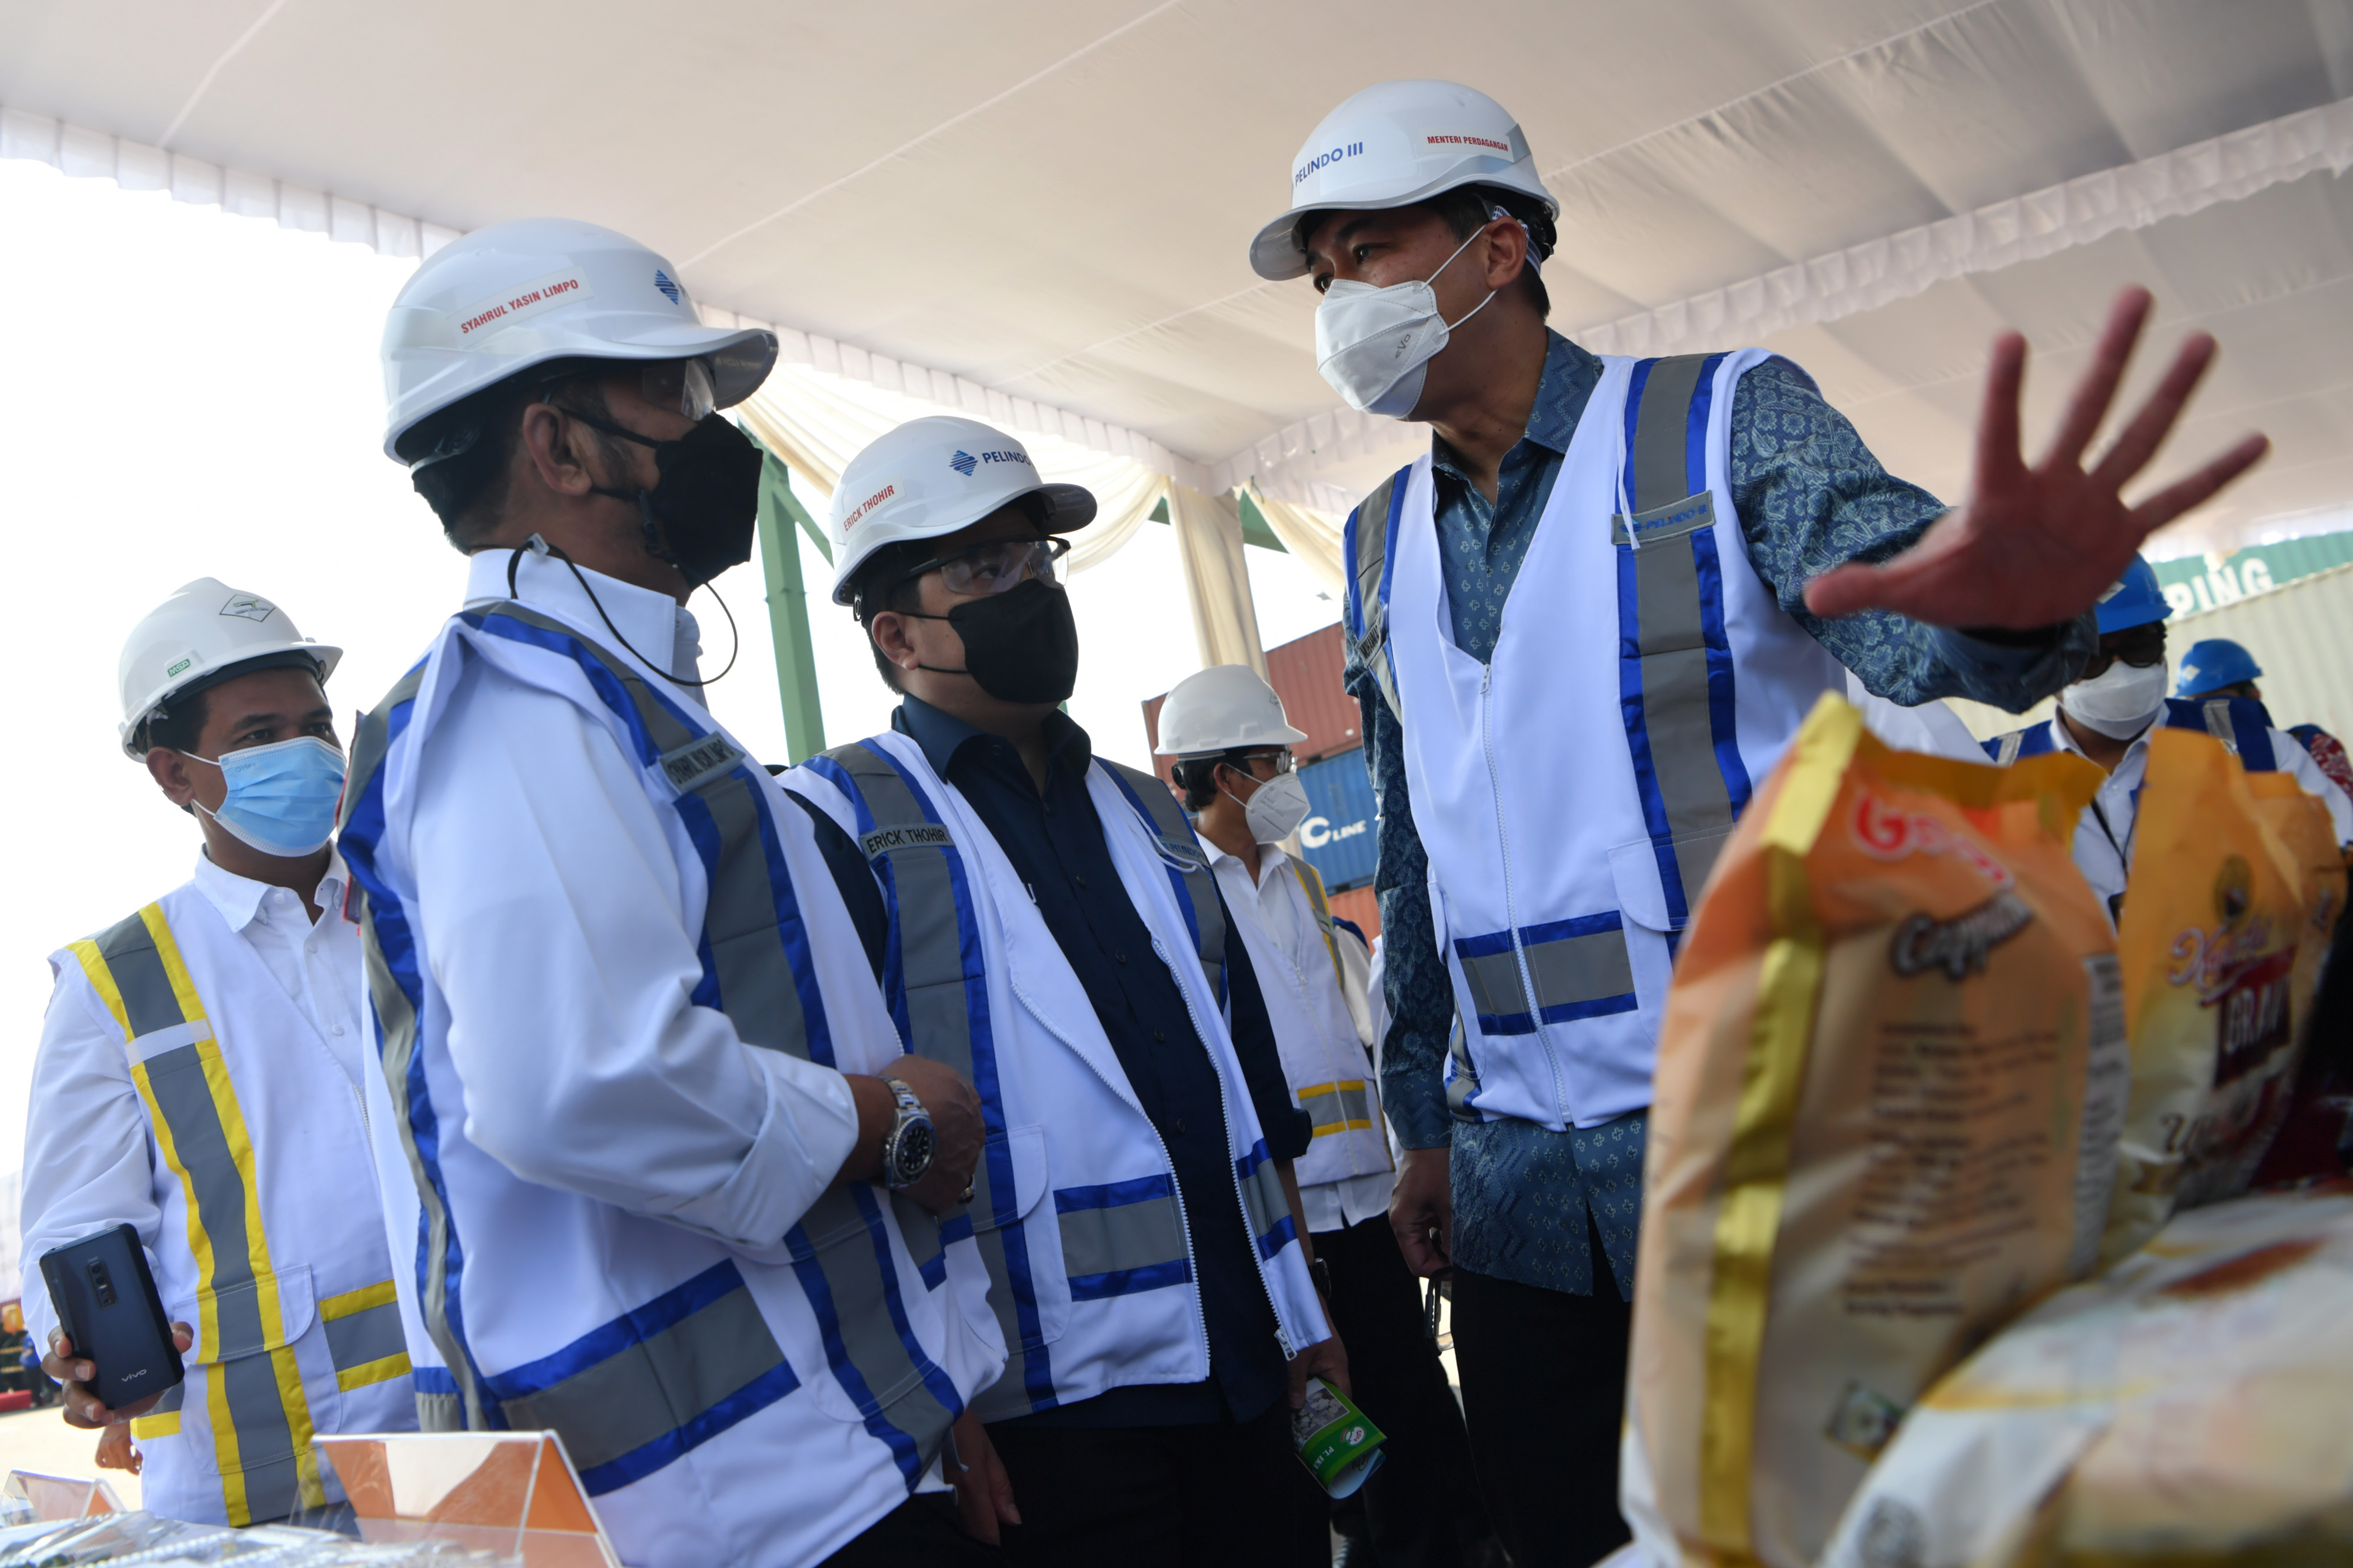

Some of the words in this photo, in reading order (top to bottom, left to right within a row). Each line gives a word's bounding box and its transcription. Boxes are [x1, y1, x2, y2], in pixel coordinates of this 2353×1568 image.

[1427, 136, 1461, 144] MENTERI
[1463, 136, 1508, 152] PERDAGANGAN
[1295, 148, 1343, 188] PELINDO
[1347, 142, 1363, 157] III
[461, 305, 508, 333] SYAHRUL
[508, 291, 541, 310] YASIN
[542, 279, 579, 298] LIMPO
[982, 451, 1031, 466] PELINDO
[844, 506, 862, 532] ERICK
[862, 485, 895, 513] THOHIR
[1646, 509, 1695, 530] PELINDO
[2164, 558, 2275, 622] PING
[169, 660, 189, 676] MSA
[866, 830, 905, 854] ERICK
[905, 828, 948, 843] THOHIR
[1300, 816, 1331, 848] C
[1332, 820, 1367, 841] LINE
[121, 1369, 147, 1382] vivo
